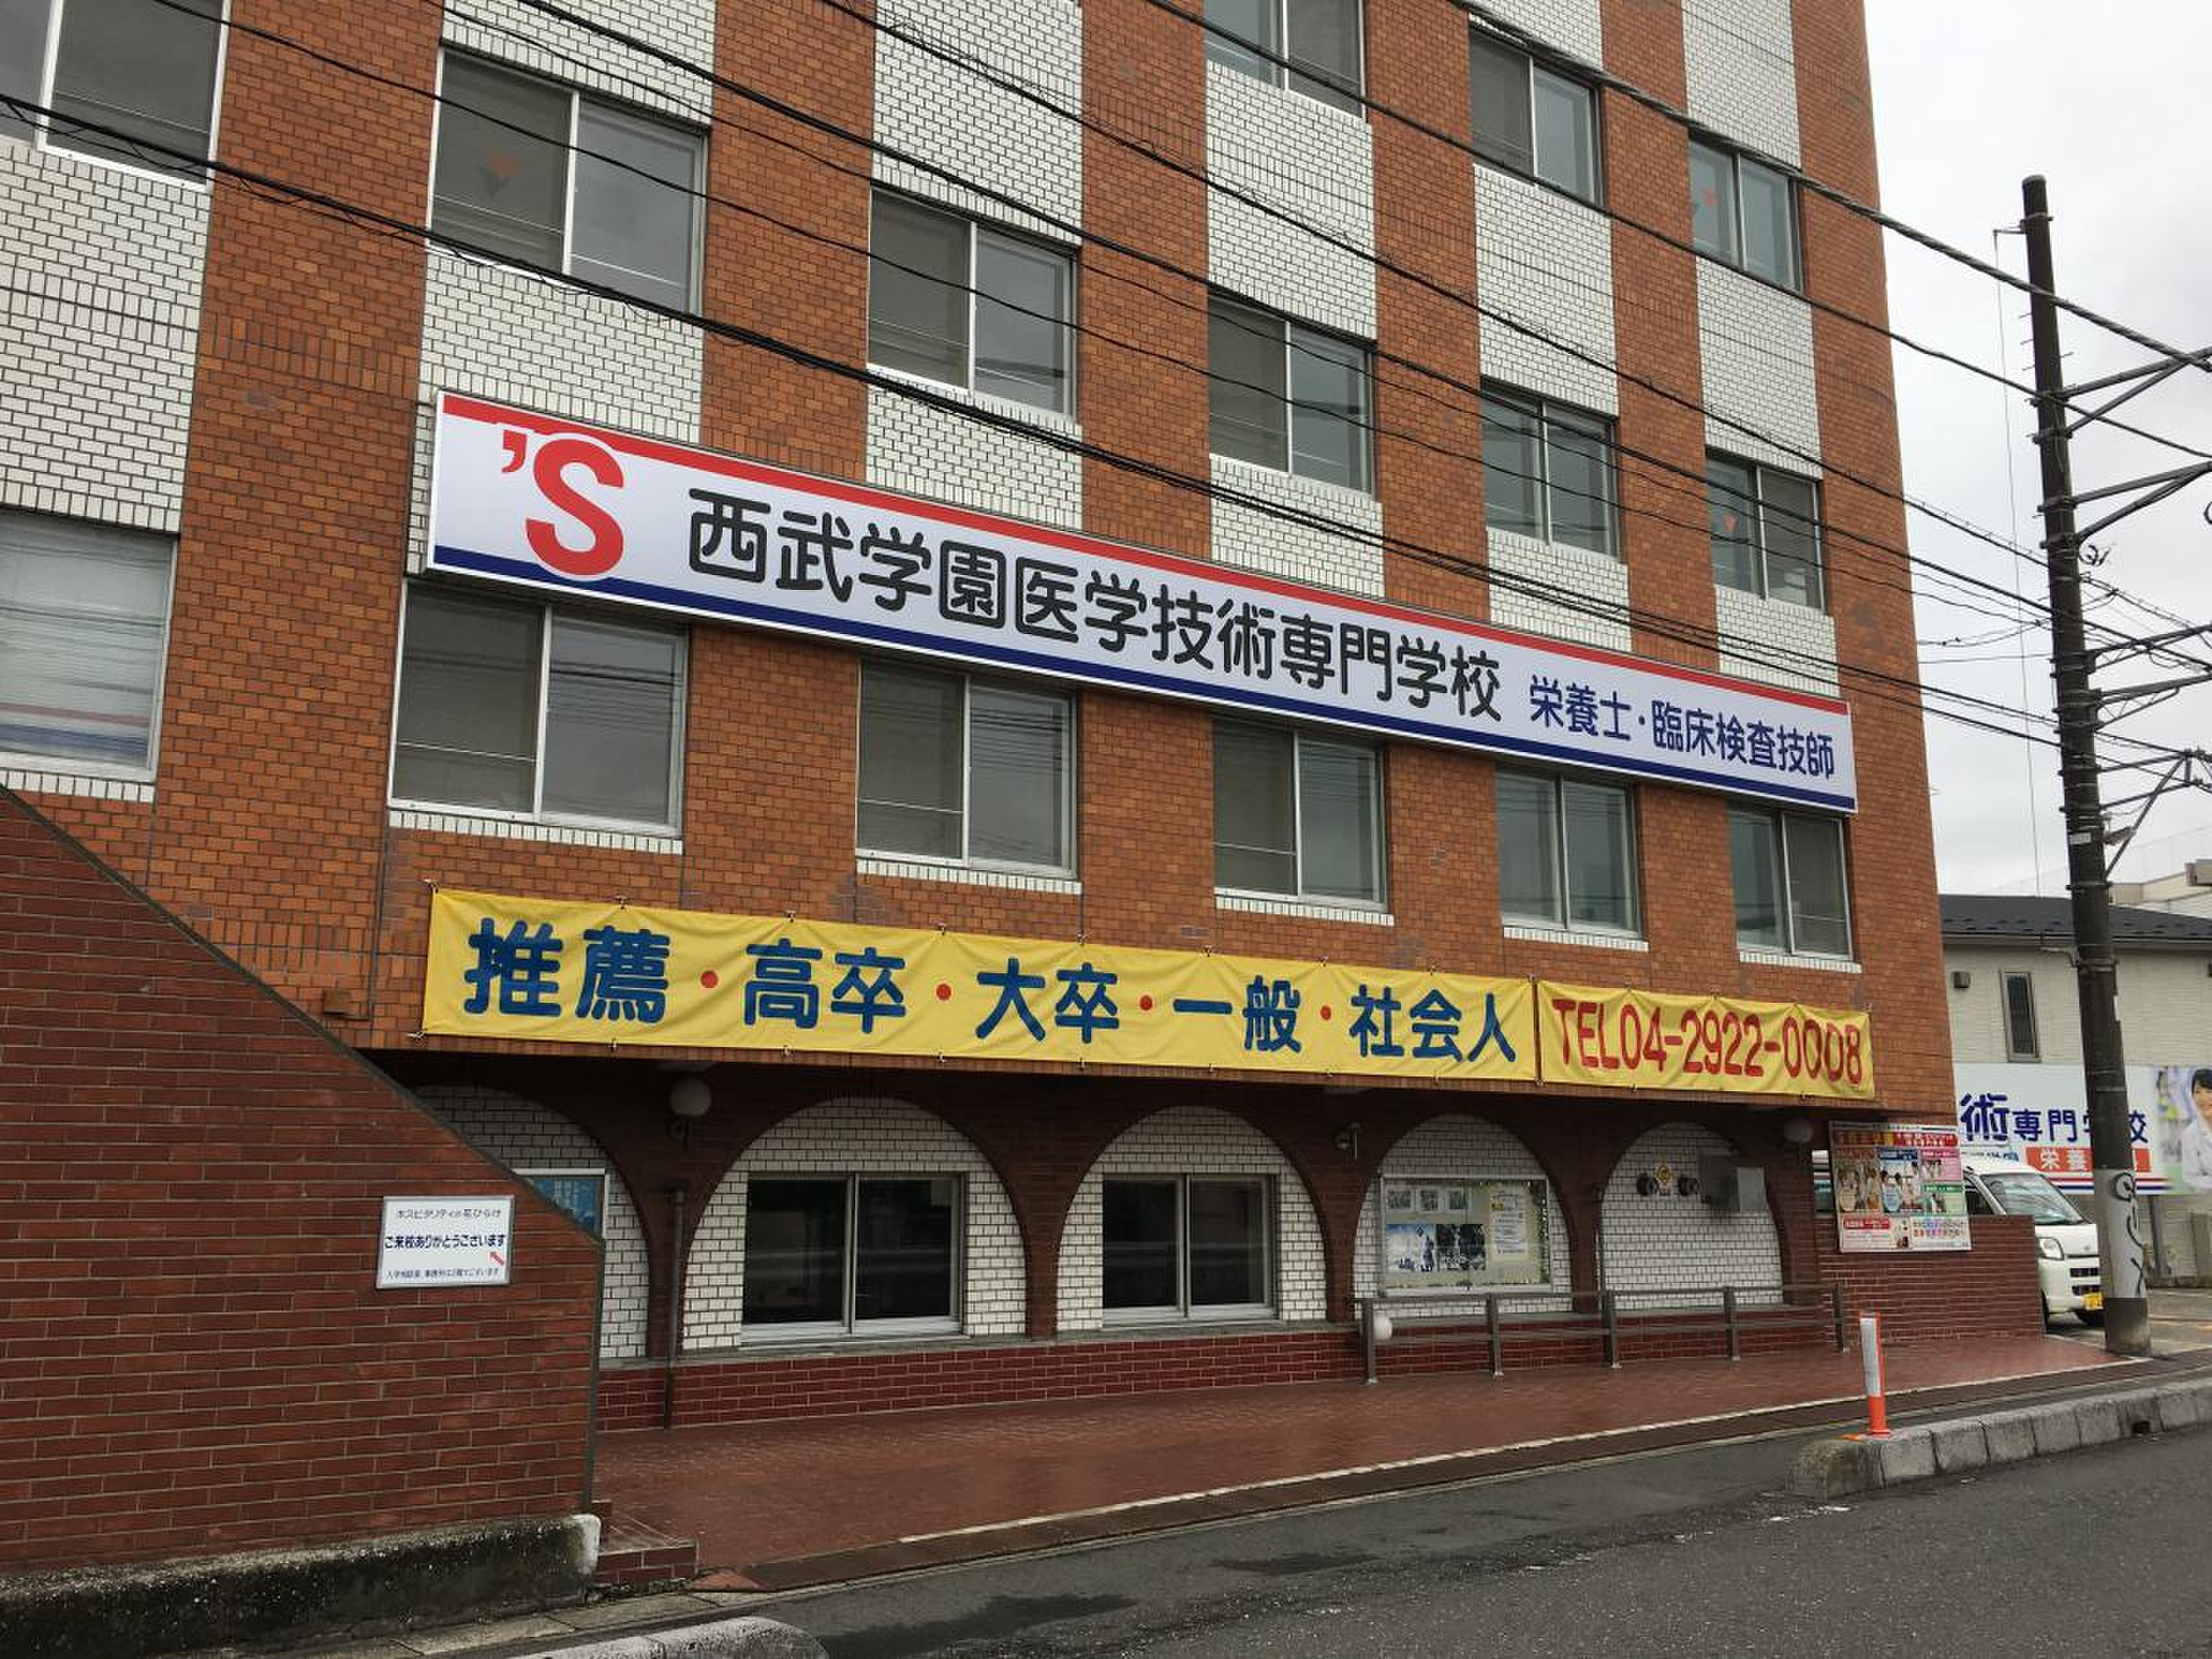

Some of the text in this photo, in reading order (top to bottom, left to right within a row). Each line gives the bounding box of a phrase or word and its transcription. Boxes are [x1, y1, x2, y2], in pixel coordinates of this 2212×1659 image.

[688, 488, 1501, 722] 西武学園医学技術専門学校
[1960, 1093, 2148, 1144] 術専門校
